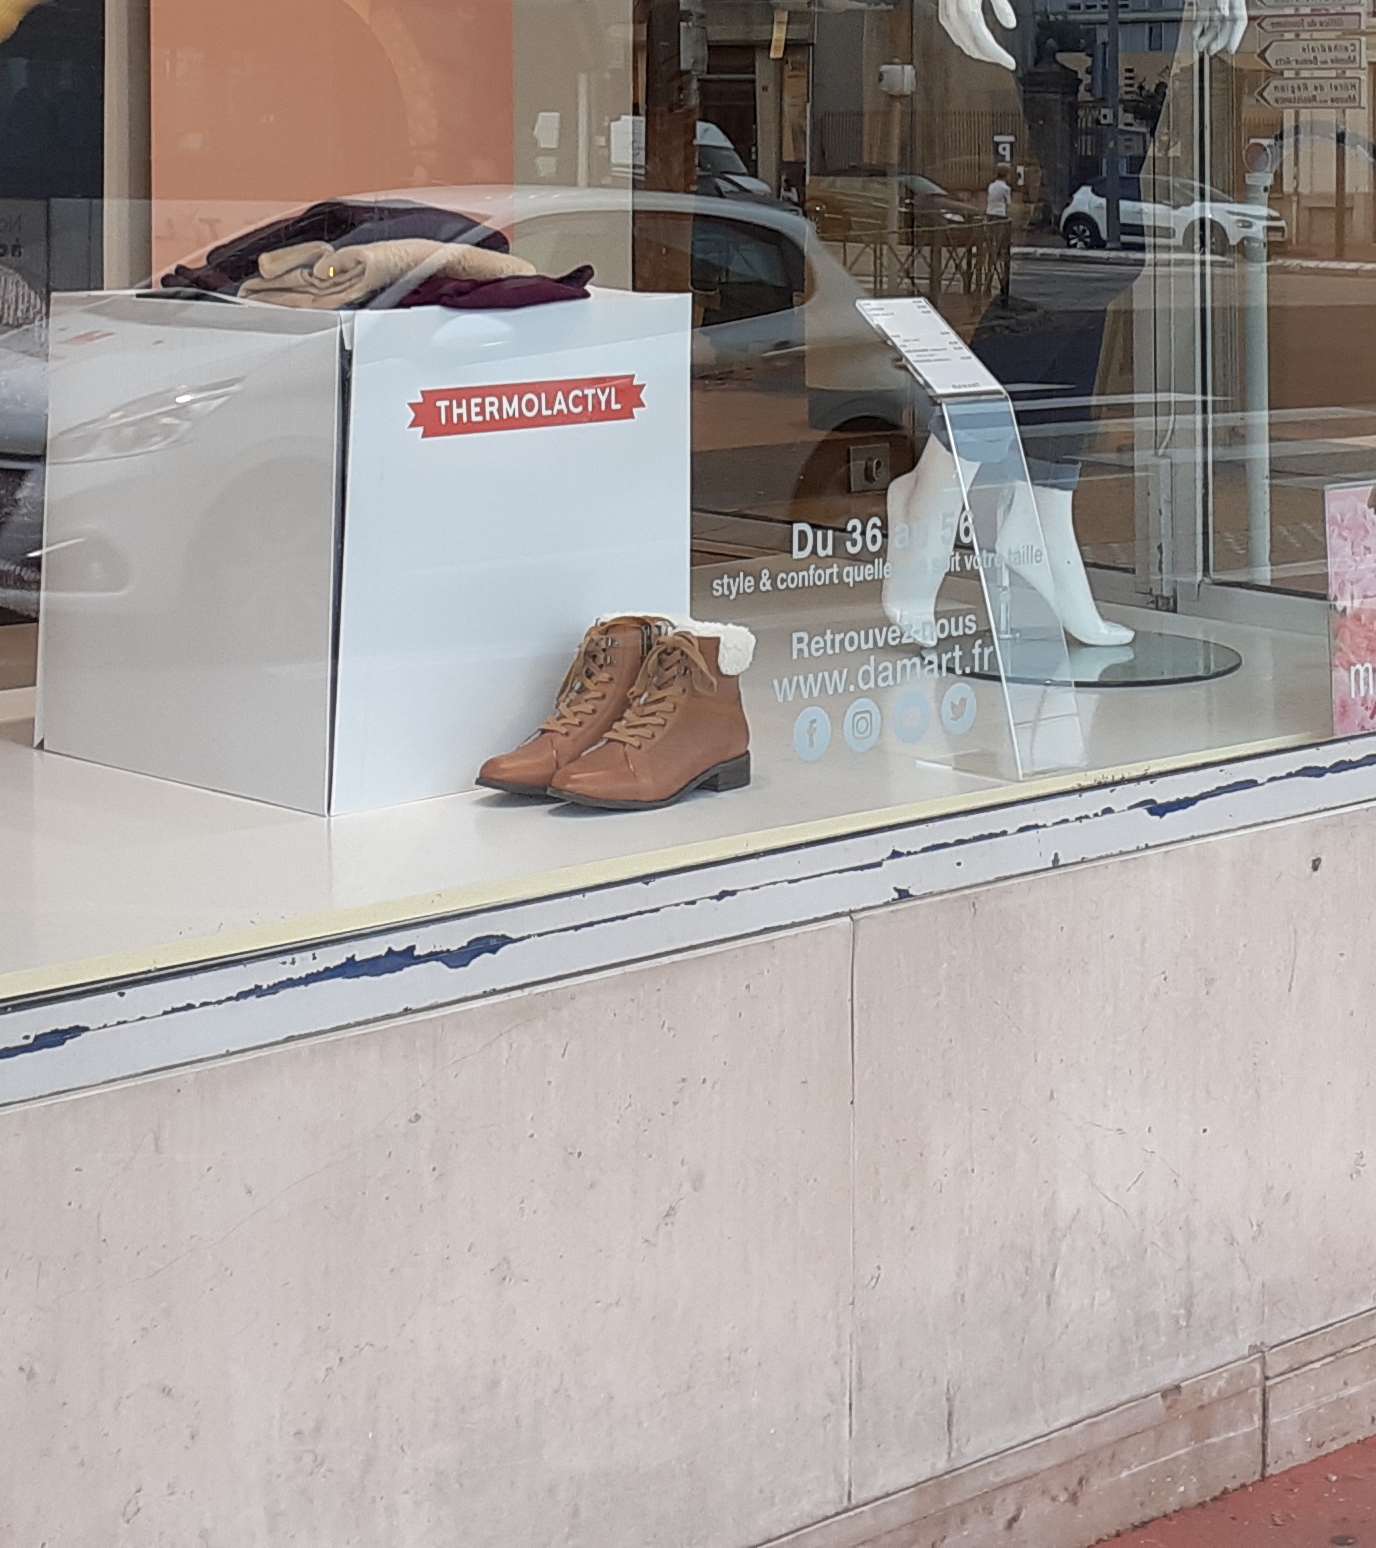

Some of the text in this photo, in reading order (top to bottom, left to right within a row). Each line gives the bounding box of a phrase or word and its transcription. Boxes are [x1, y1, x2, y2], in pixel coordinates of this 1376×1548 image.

[436, 386, 622, 425] THERMOLACTYL
[791, 522, 834, 559] Du
[845, 516, 883, 555] 36
[939, 510, 974, 545] 56
[712, 572, 755, 600] style
[759, 572, 772, 592] &
[777, 562, 839, 590] confort
[843, 558, 892, 588] quelle
[964, 548, 1005, 571] votre
[1008, 544, 1044, 566] taille
[791, 613, 977, 660] Retrouvez-nous
[773, 638, 994, 703] www.damart.fr
